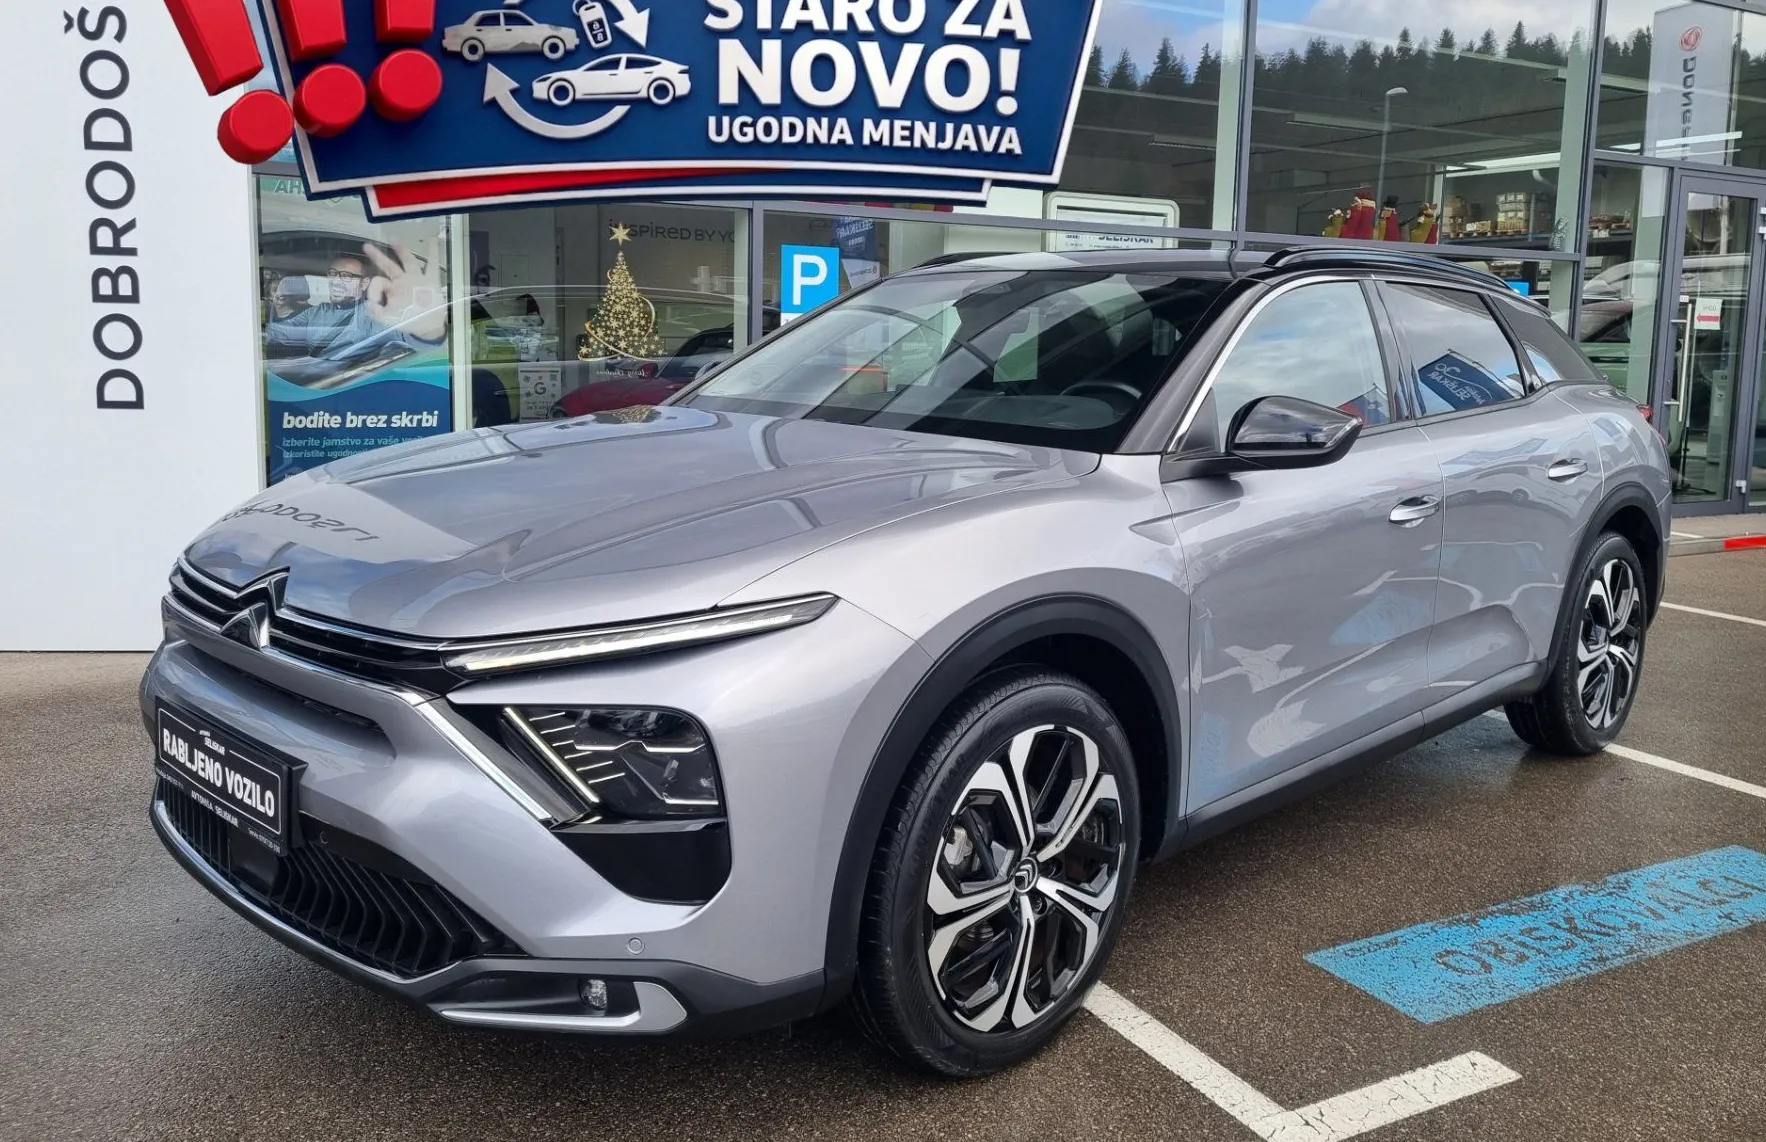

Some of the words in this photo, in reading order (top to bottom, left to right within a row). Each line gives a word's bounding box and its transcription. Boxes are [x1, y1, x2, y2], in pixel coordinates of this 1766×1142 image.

[694, 230, 715, 242] BY
[792, 254, 828, 306] P
[282, 411, 342, 429] bodite
[345, 411, 388, 428] brez
[390, 410, 439, 428] skrbi
[282, 437, 321, 447] izberite
[321, 437, 361, 448] jamstvo
[363, 438, 375, 446] za
[377, 435, 400, 445] vaše
[282, 449, 325, 459] izkoristite
[327, 449, 367, 458] ugodno
[162, 727, 223, 788] RABLJENO
[224, 766, 275, 818] VOZILO
